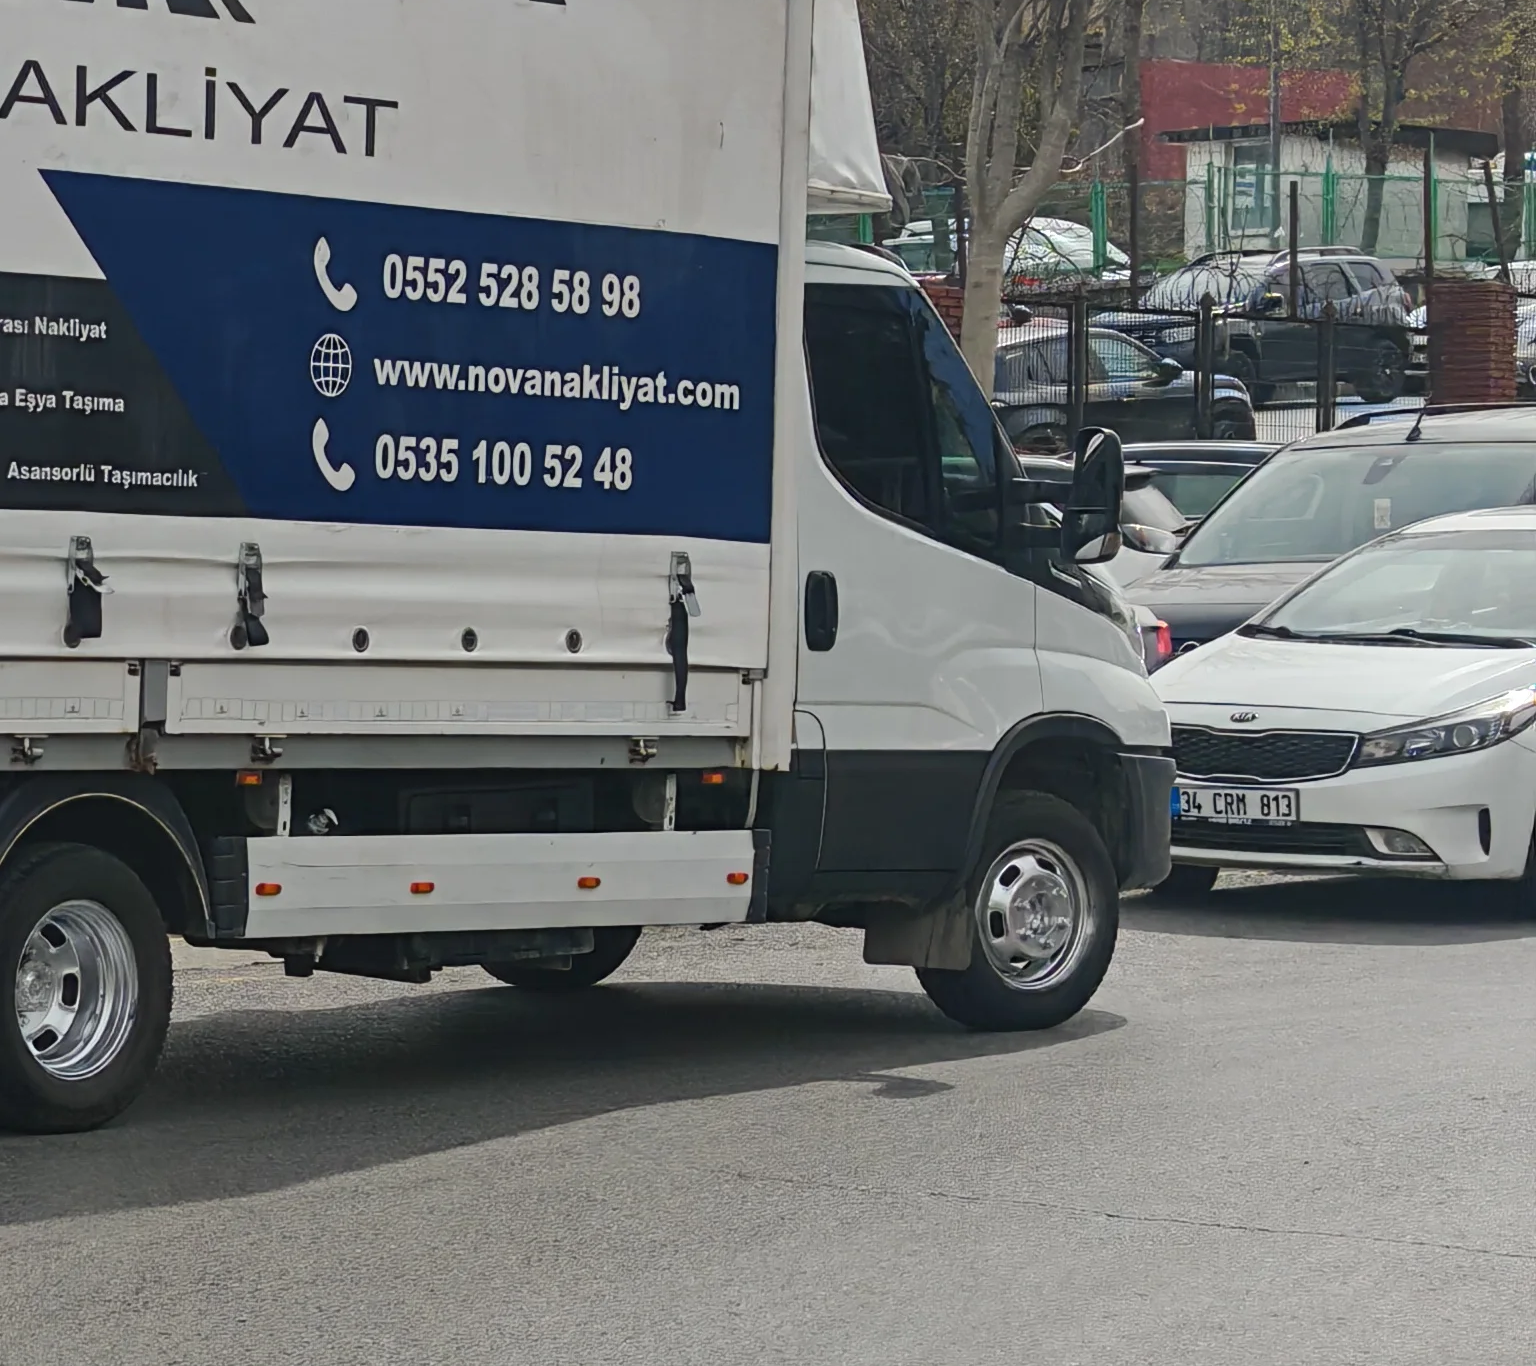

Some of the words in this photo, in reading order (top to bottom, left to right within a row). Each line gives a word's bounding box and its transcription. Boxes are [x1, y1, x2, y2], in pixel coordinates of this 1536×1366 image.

[382, 253, 467, 304] 0552
[478, 262, 540, 310] 528
[551, 268, 590, 314] 58
[601, 273, 641, 319] 98
[34, 316, 107, 342] Nakliyat
[373, 358, 741, 411] www.novanakliyat.com
[15, 388, 57, 412] Eşya
[62, 391, 125, 414] Taşıma
[374, 434, 459, 484] 0535
[472, 439, 532, 486] 100
[542, 444, 583, 488] 52
[593, 447, 633, 492] 48
[101, 465, 199, 490] Taşımacılık
[1230, 712, 1258, 723] KIA
[1180, 790, 1202, 814] 34
[1212, 792, 1247, 816] CRM
[1259, 793, 1292, 818] 813
